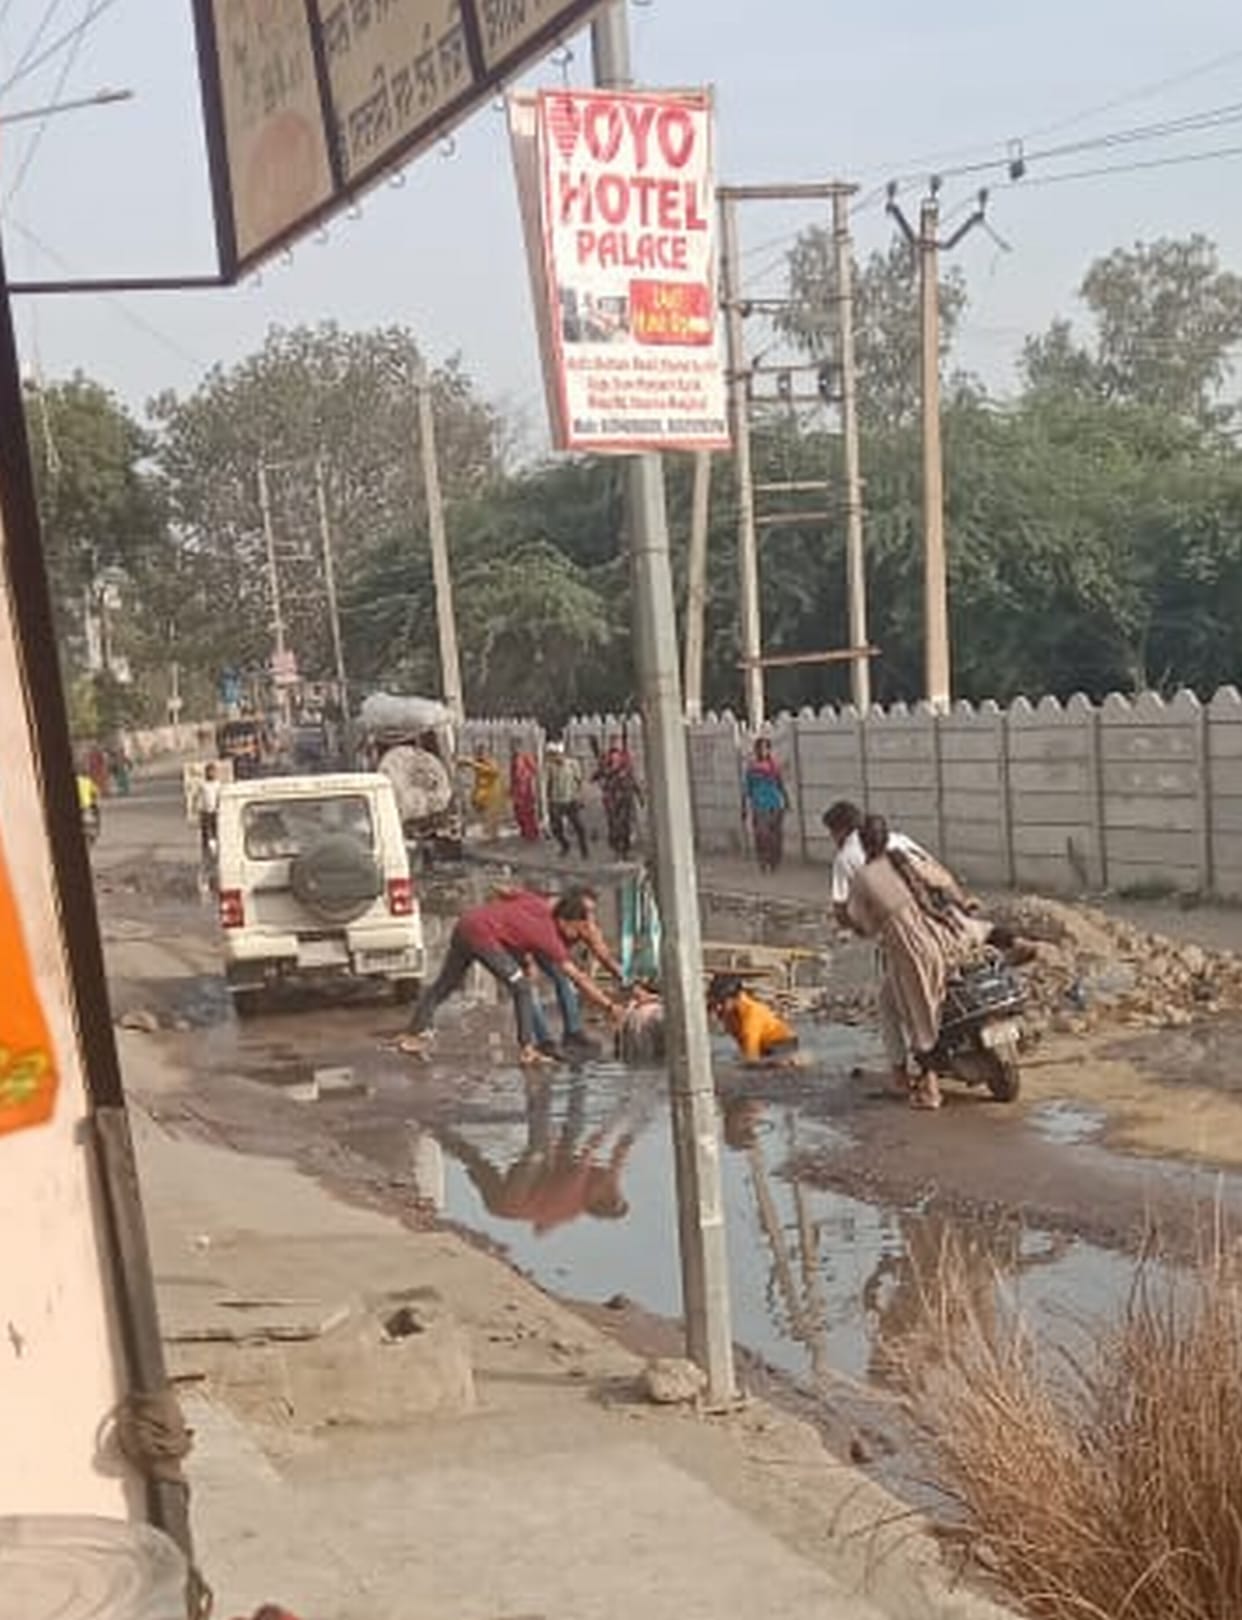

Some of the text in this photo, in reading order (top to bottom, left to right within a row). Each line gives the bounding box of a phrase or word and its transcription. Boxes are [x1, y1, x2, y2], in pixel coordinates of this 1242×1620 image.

[584, 101, 694, 168] OYO
[559, 171, 707, 230] HOTEL
[577, 230, 687, 270] PALACE
